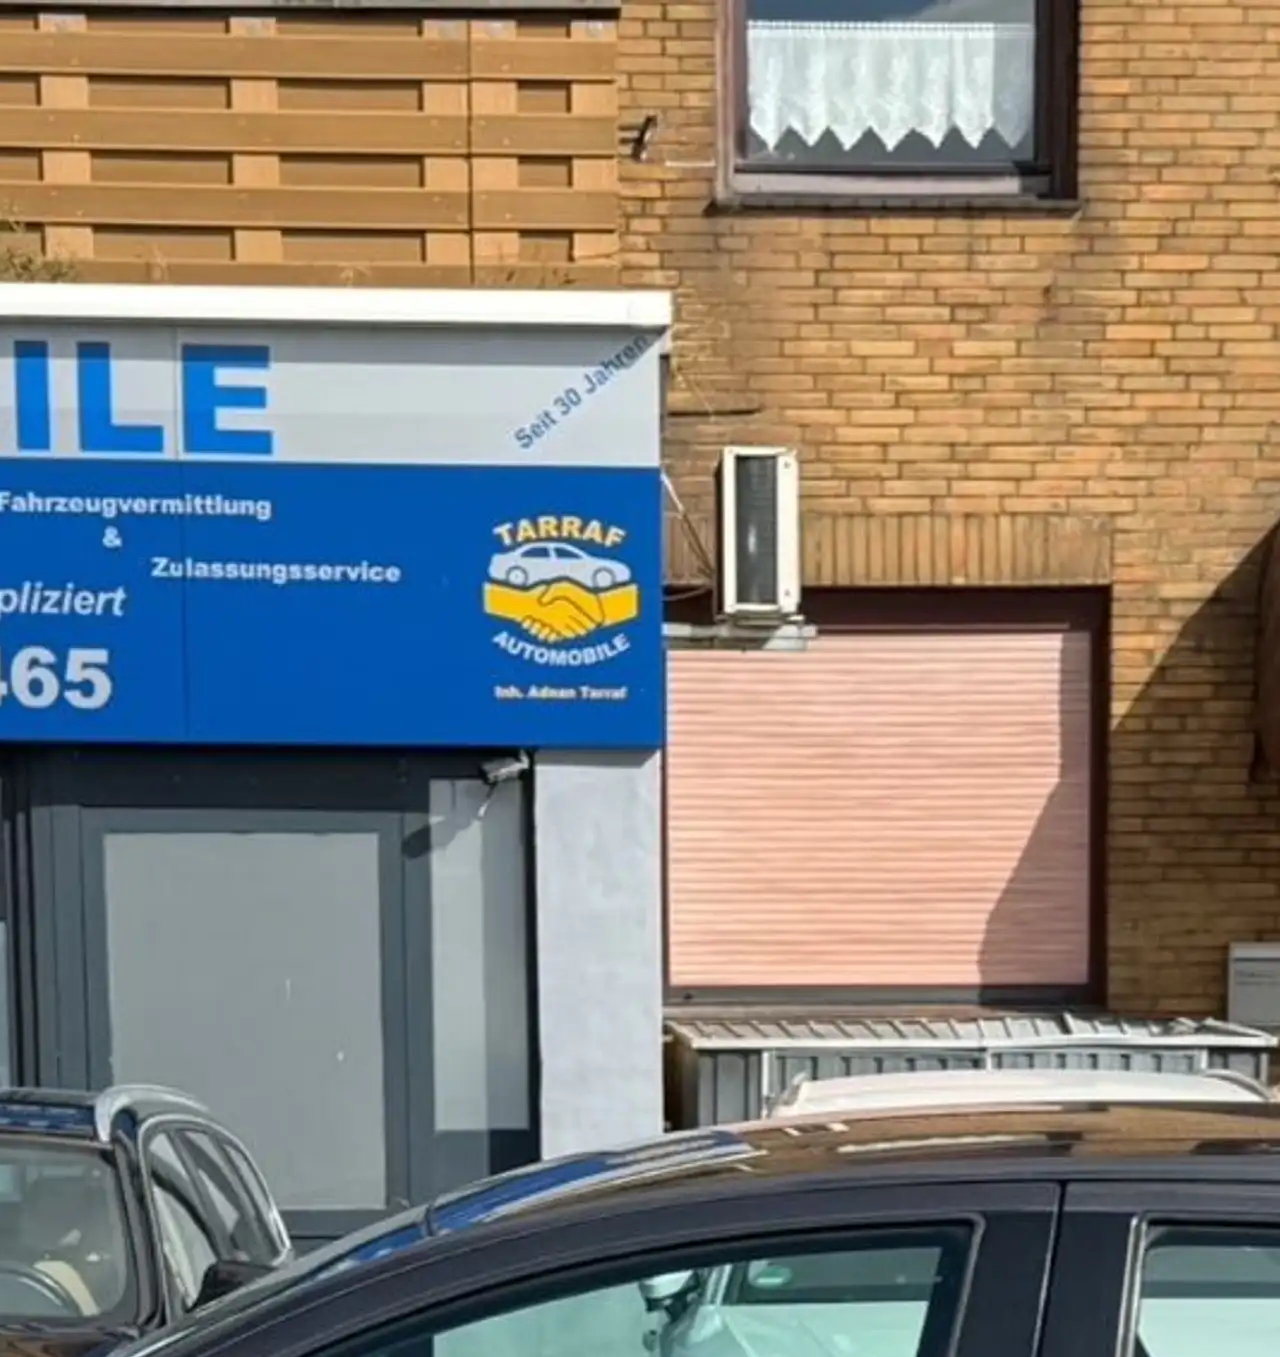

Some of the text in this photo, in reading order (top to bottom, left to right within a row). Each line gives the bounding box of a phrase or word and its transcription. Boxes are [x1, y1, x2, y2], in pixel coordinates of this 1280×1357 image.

[513, 335, 649, 449] Seit 30 Jahren
[102, 527, 122, 548] &
[493, 515, 626, 547] TARRAF
[151, 557, 401, 585] Zulassungsservice
[491, 630, 631, 667] AUTOMOBILE
